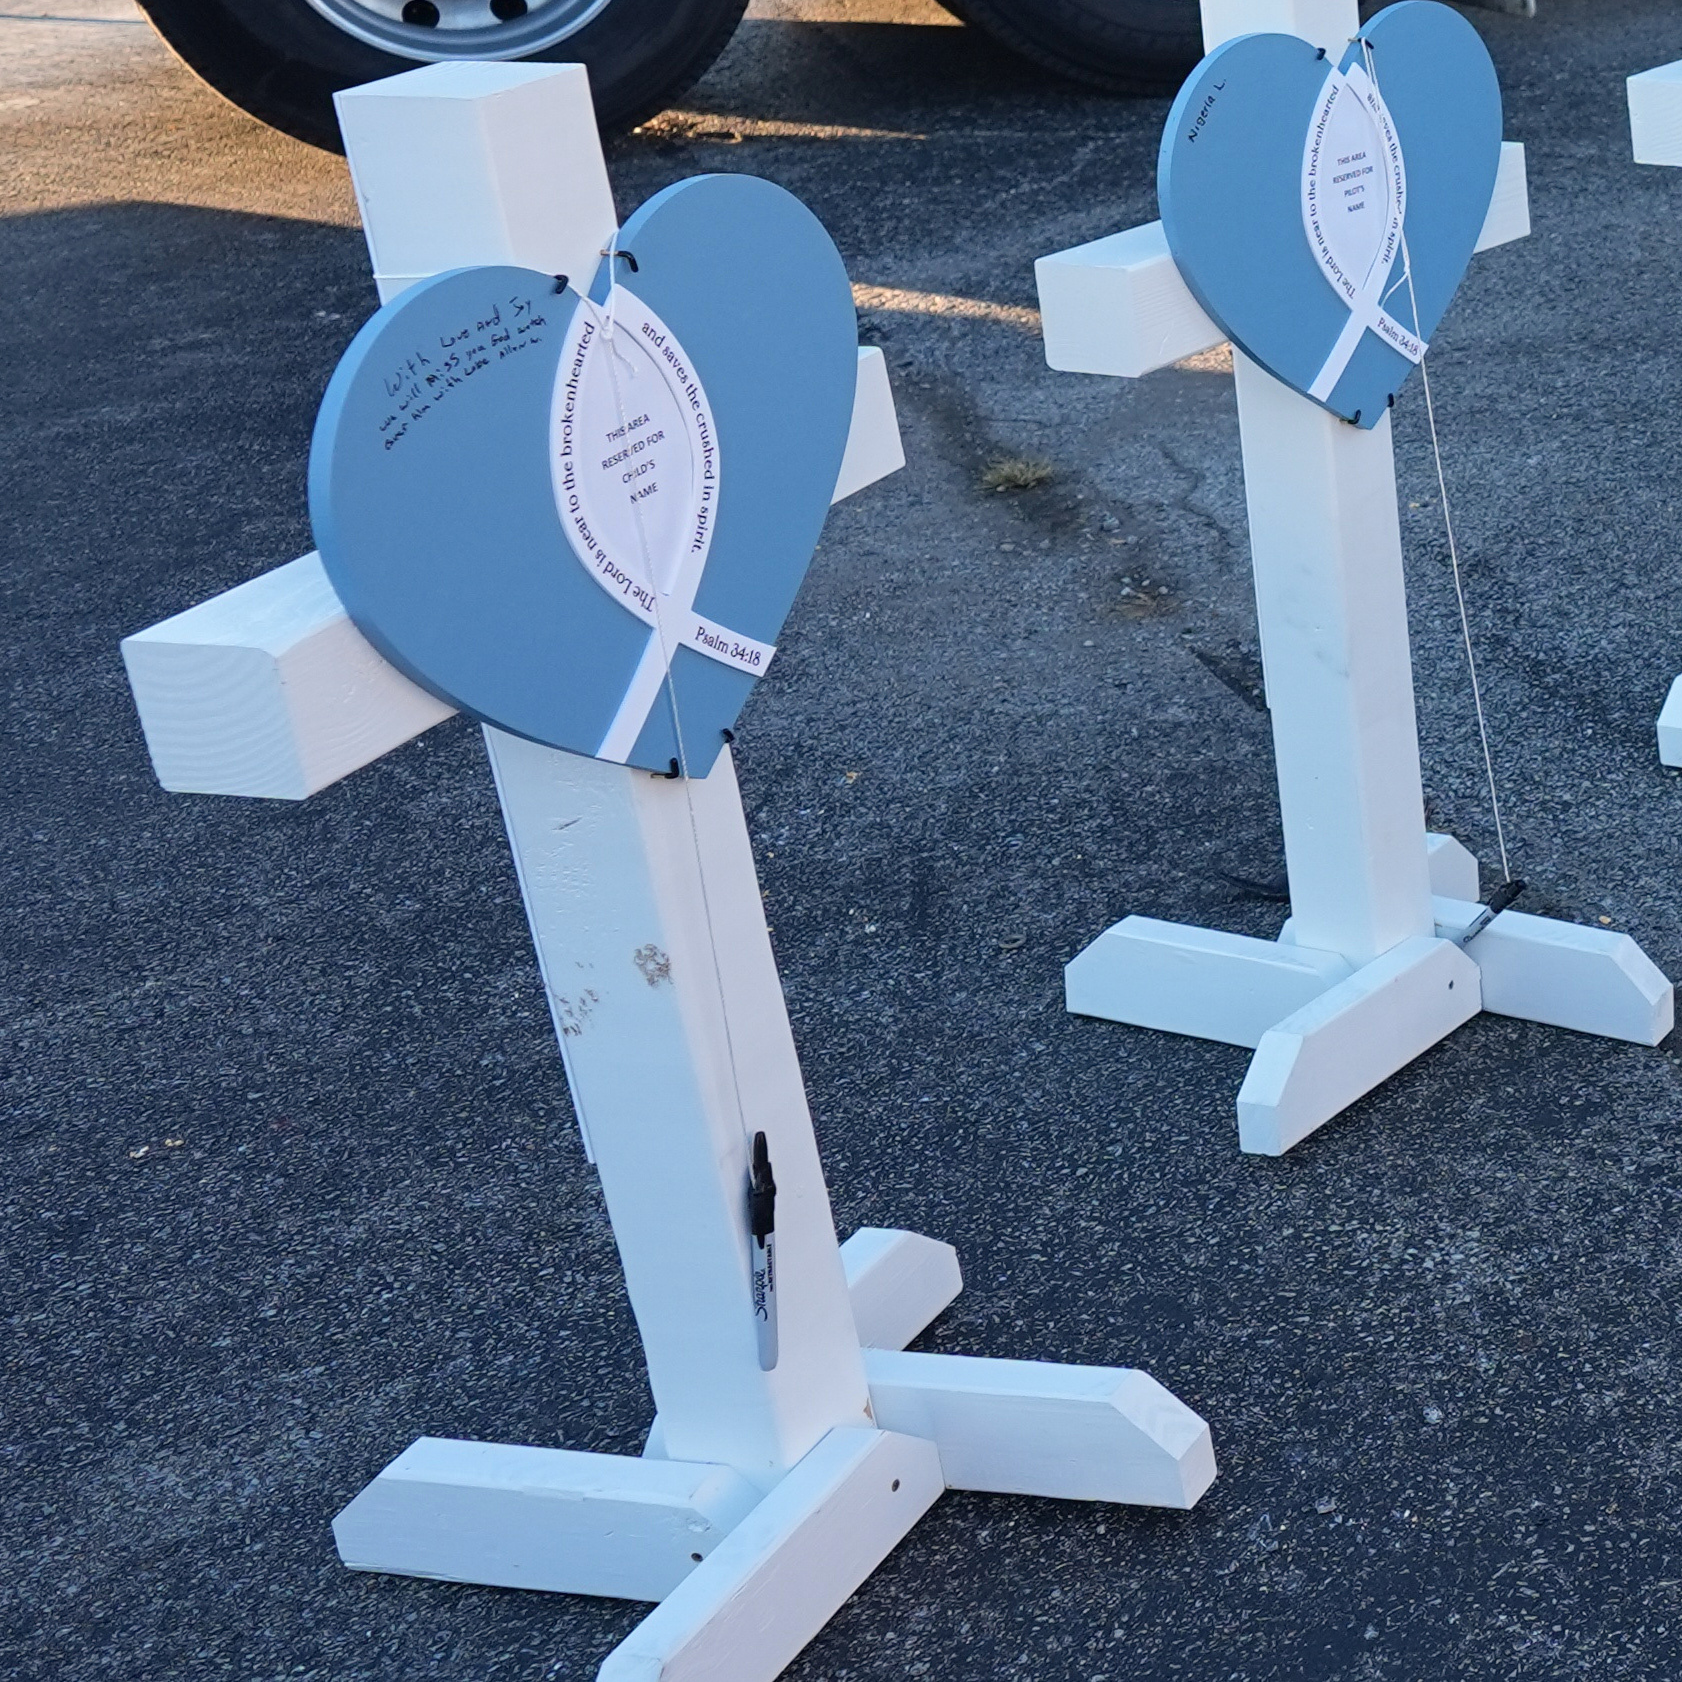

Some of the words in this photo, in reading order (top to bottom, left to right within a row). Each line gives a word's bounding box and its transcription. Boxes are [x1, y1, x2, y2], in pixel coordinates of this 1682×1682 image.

[641, 322, 666, 348] and
[1377, 317, 1399, 341] Psalm
[662, 346, 688, 384] saves
[560, 321, 596, 458] brokenhearted
[685, 383, 702, 412] the
[605, 426, 626, 443] THIS
[626, 413, 650, 434] AREA
[601, 439, 646, 471] RESERVED
[646, 430, 665, 447] FOR
[695, 412, 715, 480] crushed
[562, 461, 576, 491] the
[568, 494, 580, 513] to
[630, 482, 659, 505] NAME
[702, 485, 715, 502] in
[574, 516, 597, 551] near
[691, 505, 710, 554] spirit.
[595, 548, 607, 568] is
[603, 561, 633, 595] Lord
[632, 585, 656, 613] The
[694, 625, 730, 654] Psalm
[730, 642, 762, 667] 34:18
